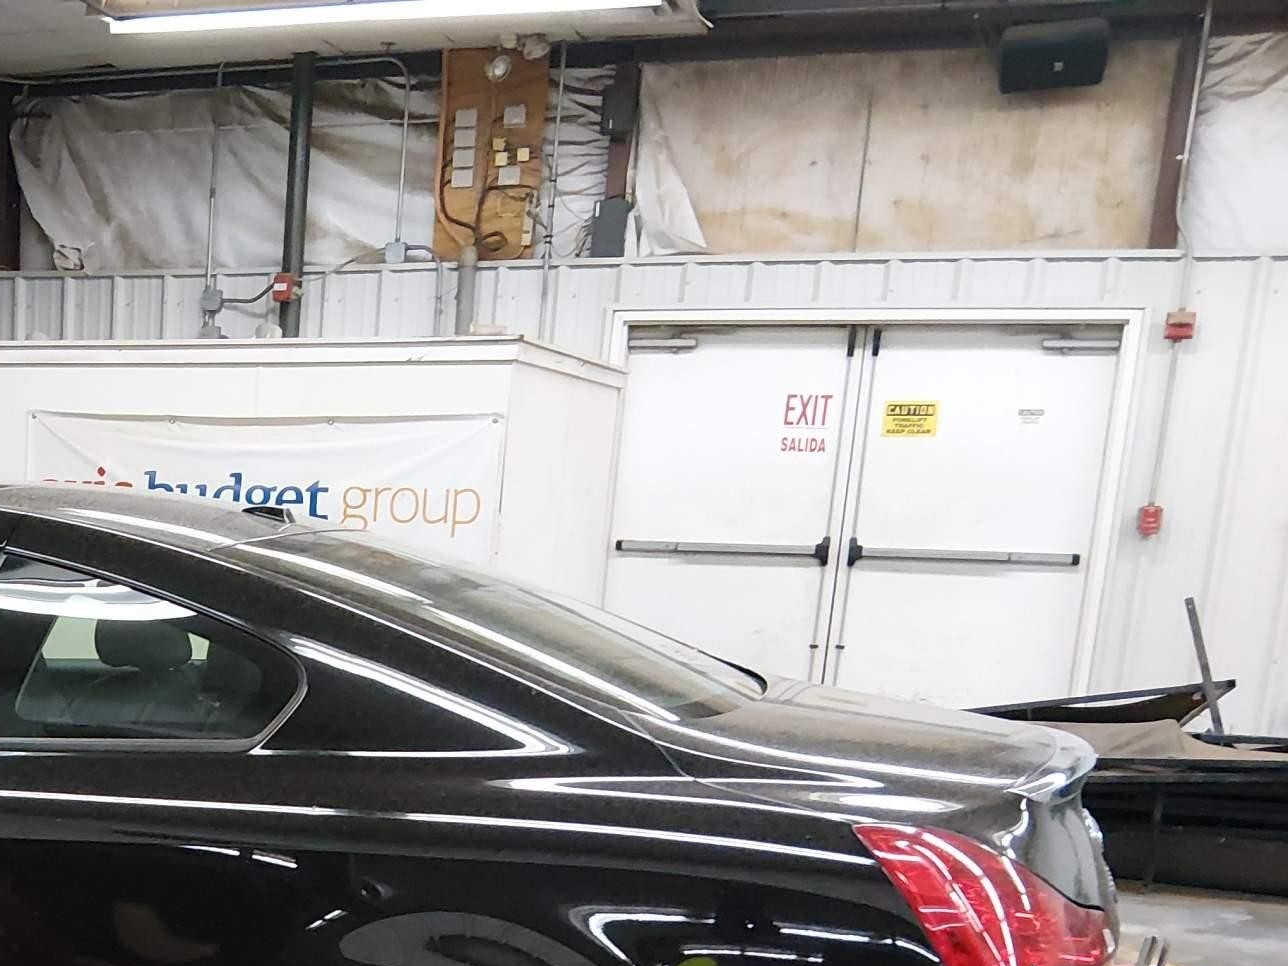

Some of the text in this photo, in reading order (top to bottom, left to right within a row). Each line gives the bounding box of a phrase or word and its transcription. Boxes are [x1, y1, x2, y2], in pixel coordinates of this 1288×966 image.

[783, 394, 833, 426] EXIT
[780, 437, 826, 452] SALIDA
[340, 486, 481, 538] group
